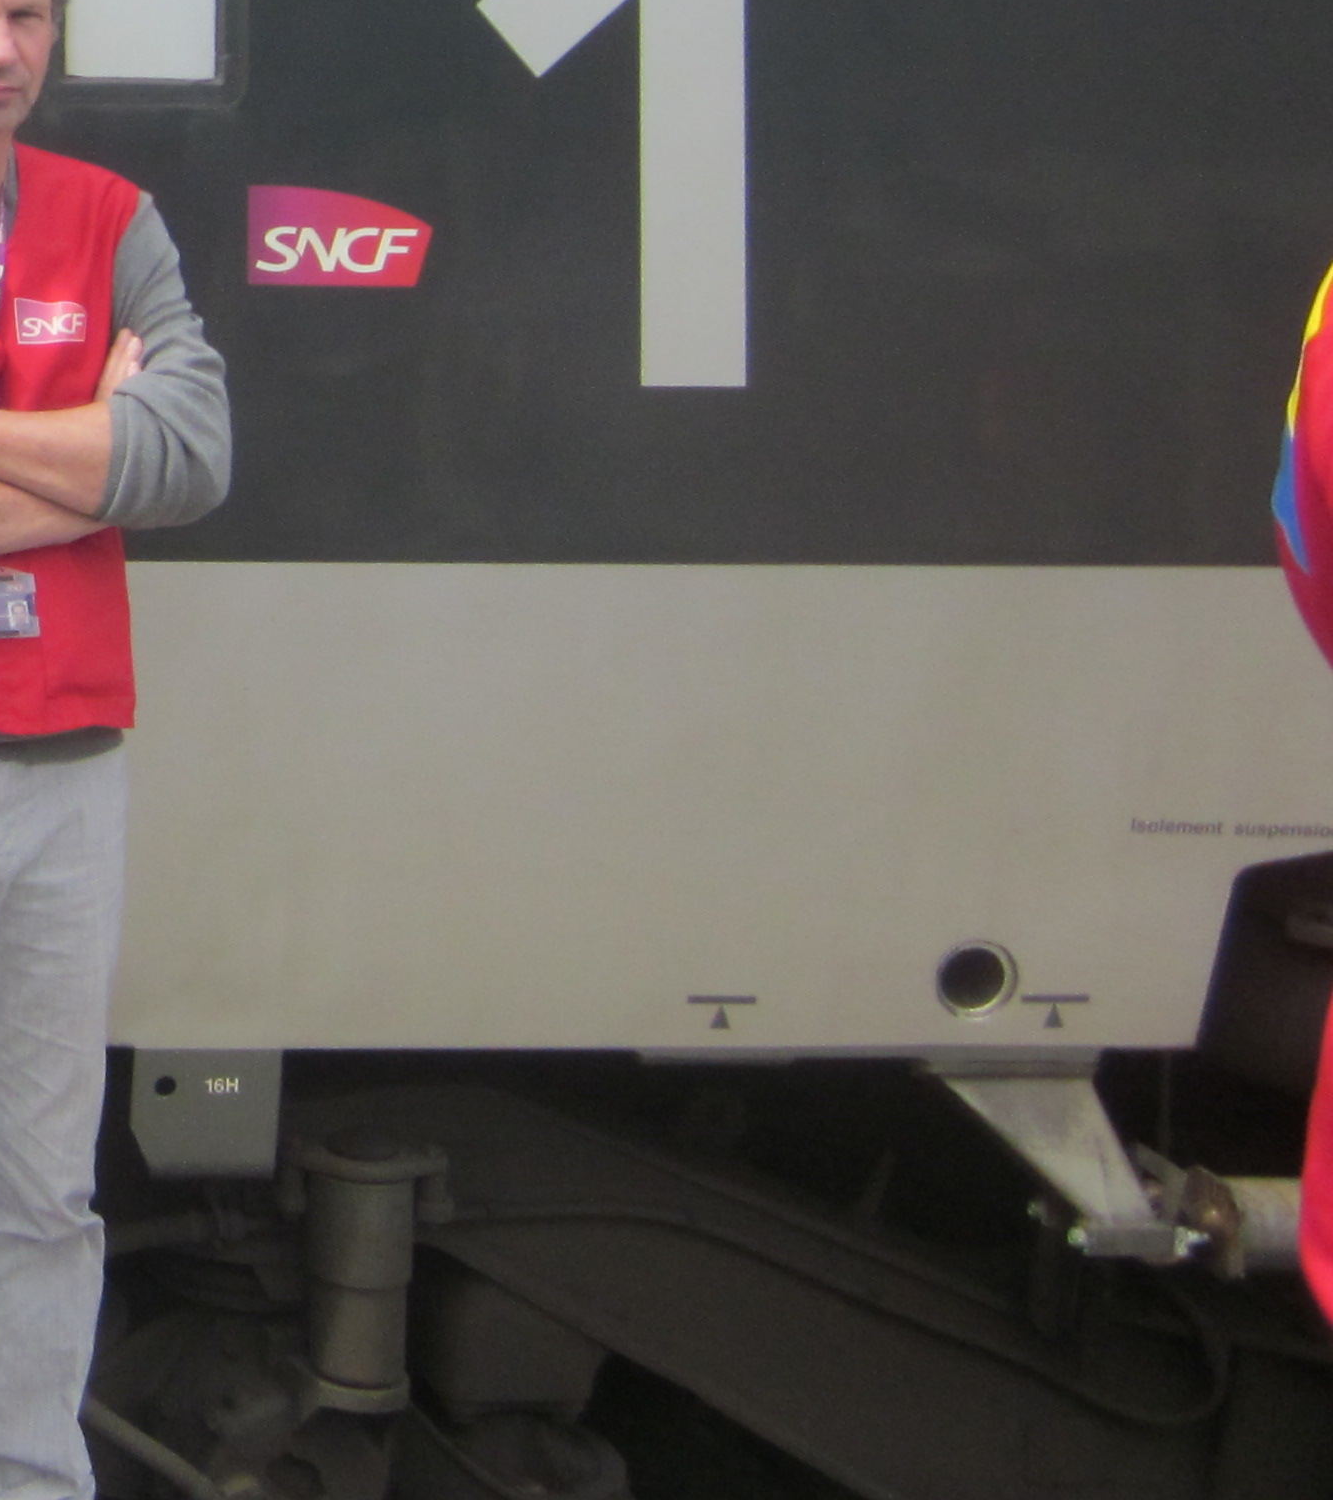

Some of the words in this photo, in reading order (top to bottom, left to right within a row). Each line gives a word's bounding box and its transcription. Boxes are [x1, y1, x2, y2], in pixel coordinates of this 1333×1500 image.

[255, 226, 419, 273] SNCF
[22, 312, 85, 338] SNCF
[205, 1077, 240, 1093] 16H
